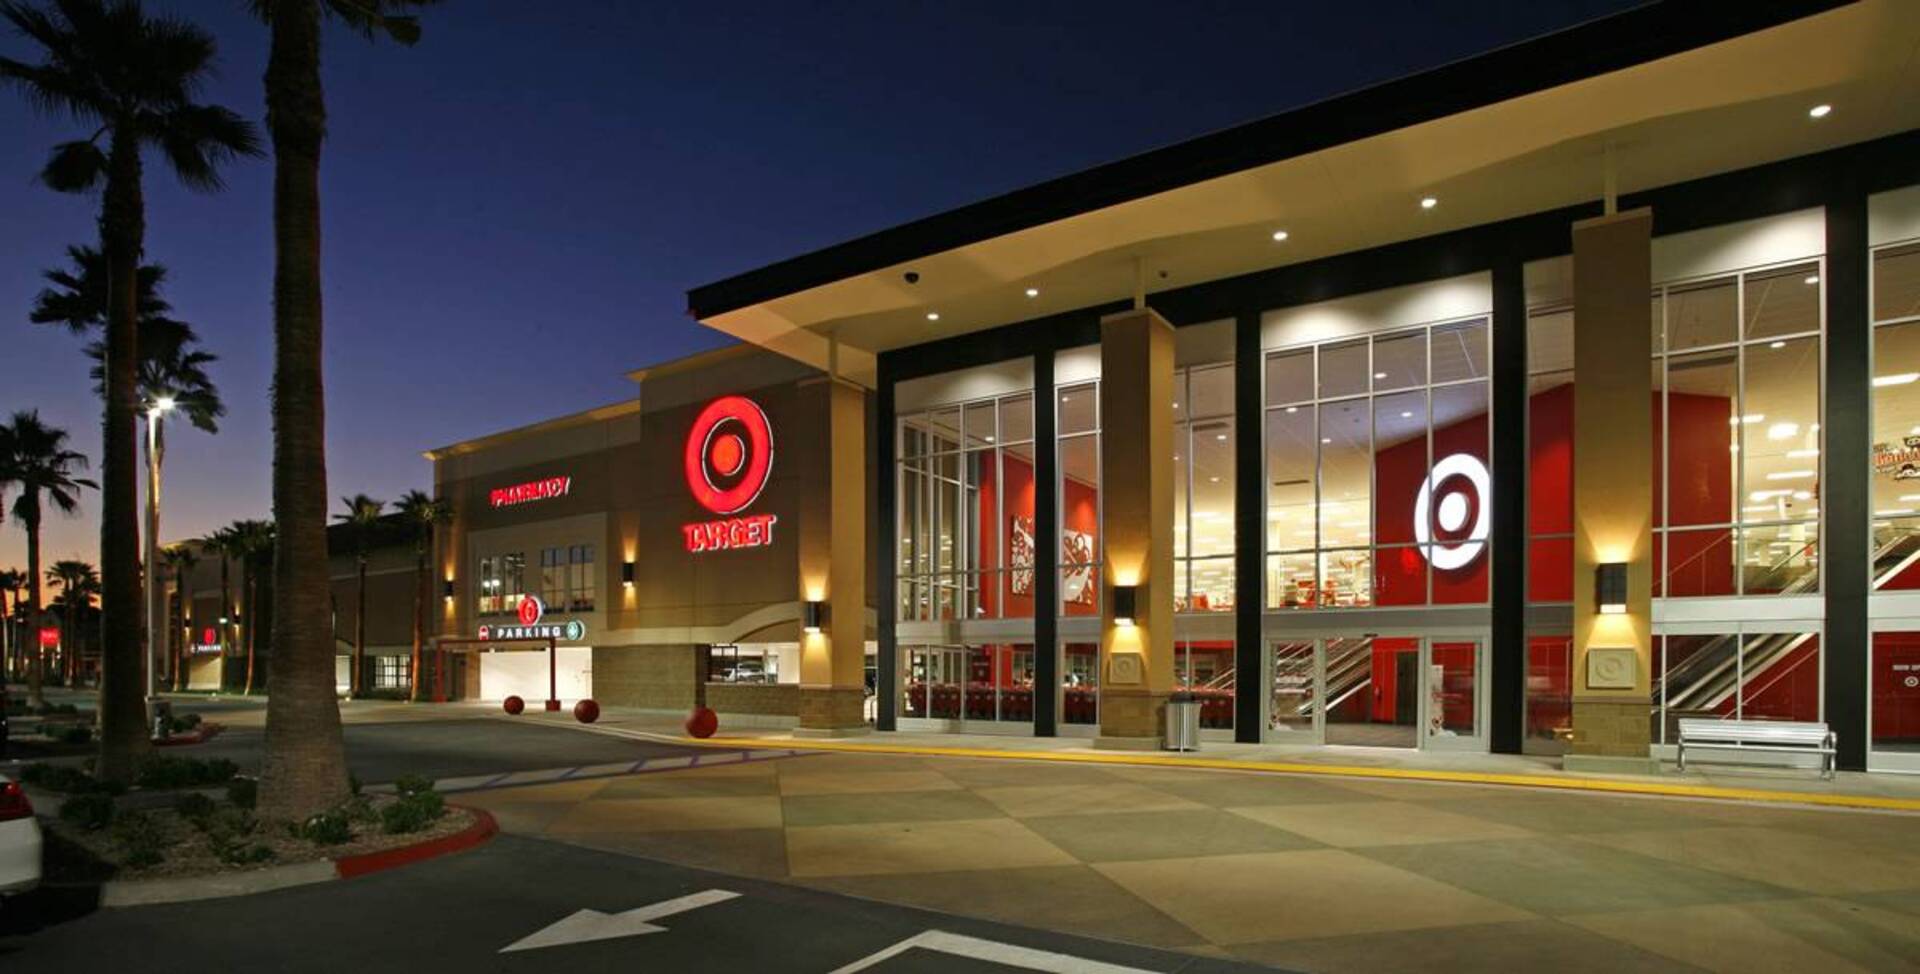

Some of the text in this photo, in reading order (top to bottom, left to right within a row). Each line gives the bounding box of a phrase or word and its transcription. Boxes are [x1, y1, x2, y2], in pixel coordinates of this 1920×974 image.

[490, 476, 570, 506] PHARMACY
[683, 515, 777, 552] TARGET
[497, 626, 561, 638] PARKING
